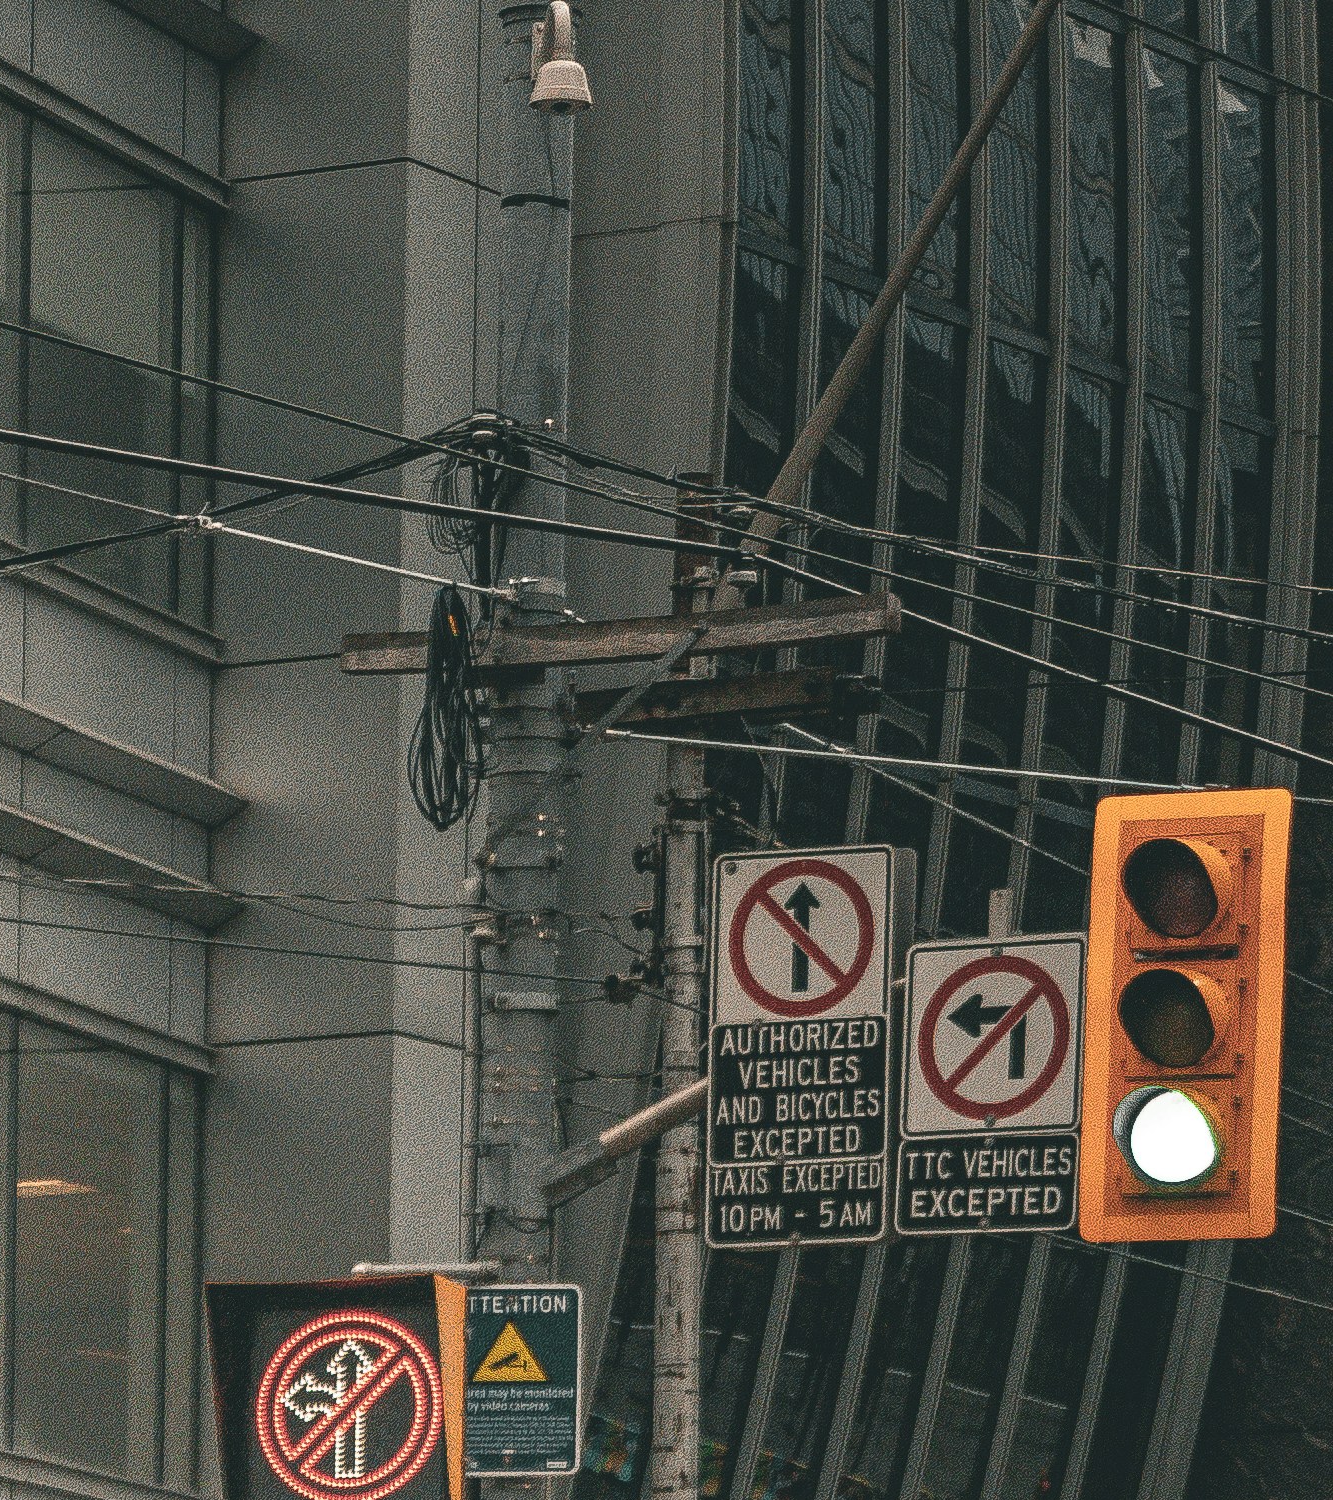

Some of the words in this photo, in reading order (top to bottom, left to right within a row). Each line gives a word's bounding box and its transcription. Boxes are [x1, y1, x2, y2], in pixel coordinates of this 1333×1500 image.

[720, 1020, 879, 1056] AUTHORIZED
[738, 1055, 862, 1089] VEHICLES
[716, 1096, 763, 1125] AND
[776, 1089, 881, 1121] BICYCLES
[734, 1125, 861, 1158] EXCEPTED
[712, 1168, 770, 1196] TAXIS
[782, 1162, 881, 1193] EXCEPTED
[906, 1150, 954, 1180] TTC
[963, 1147, 1071, 1178] VEHICLES
[910, 1186, 1062, 1218] EXCEPTED
[468, 1295, 568, 1314] TTENTION
